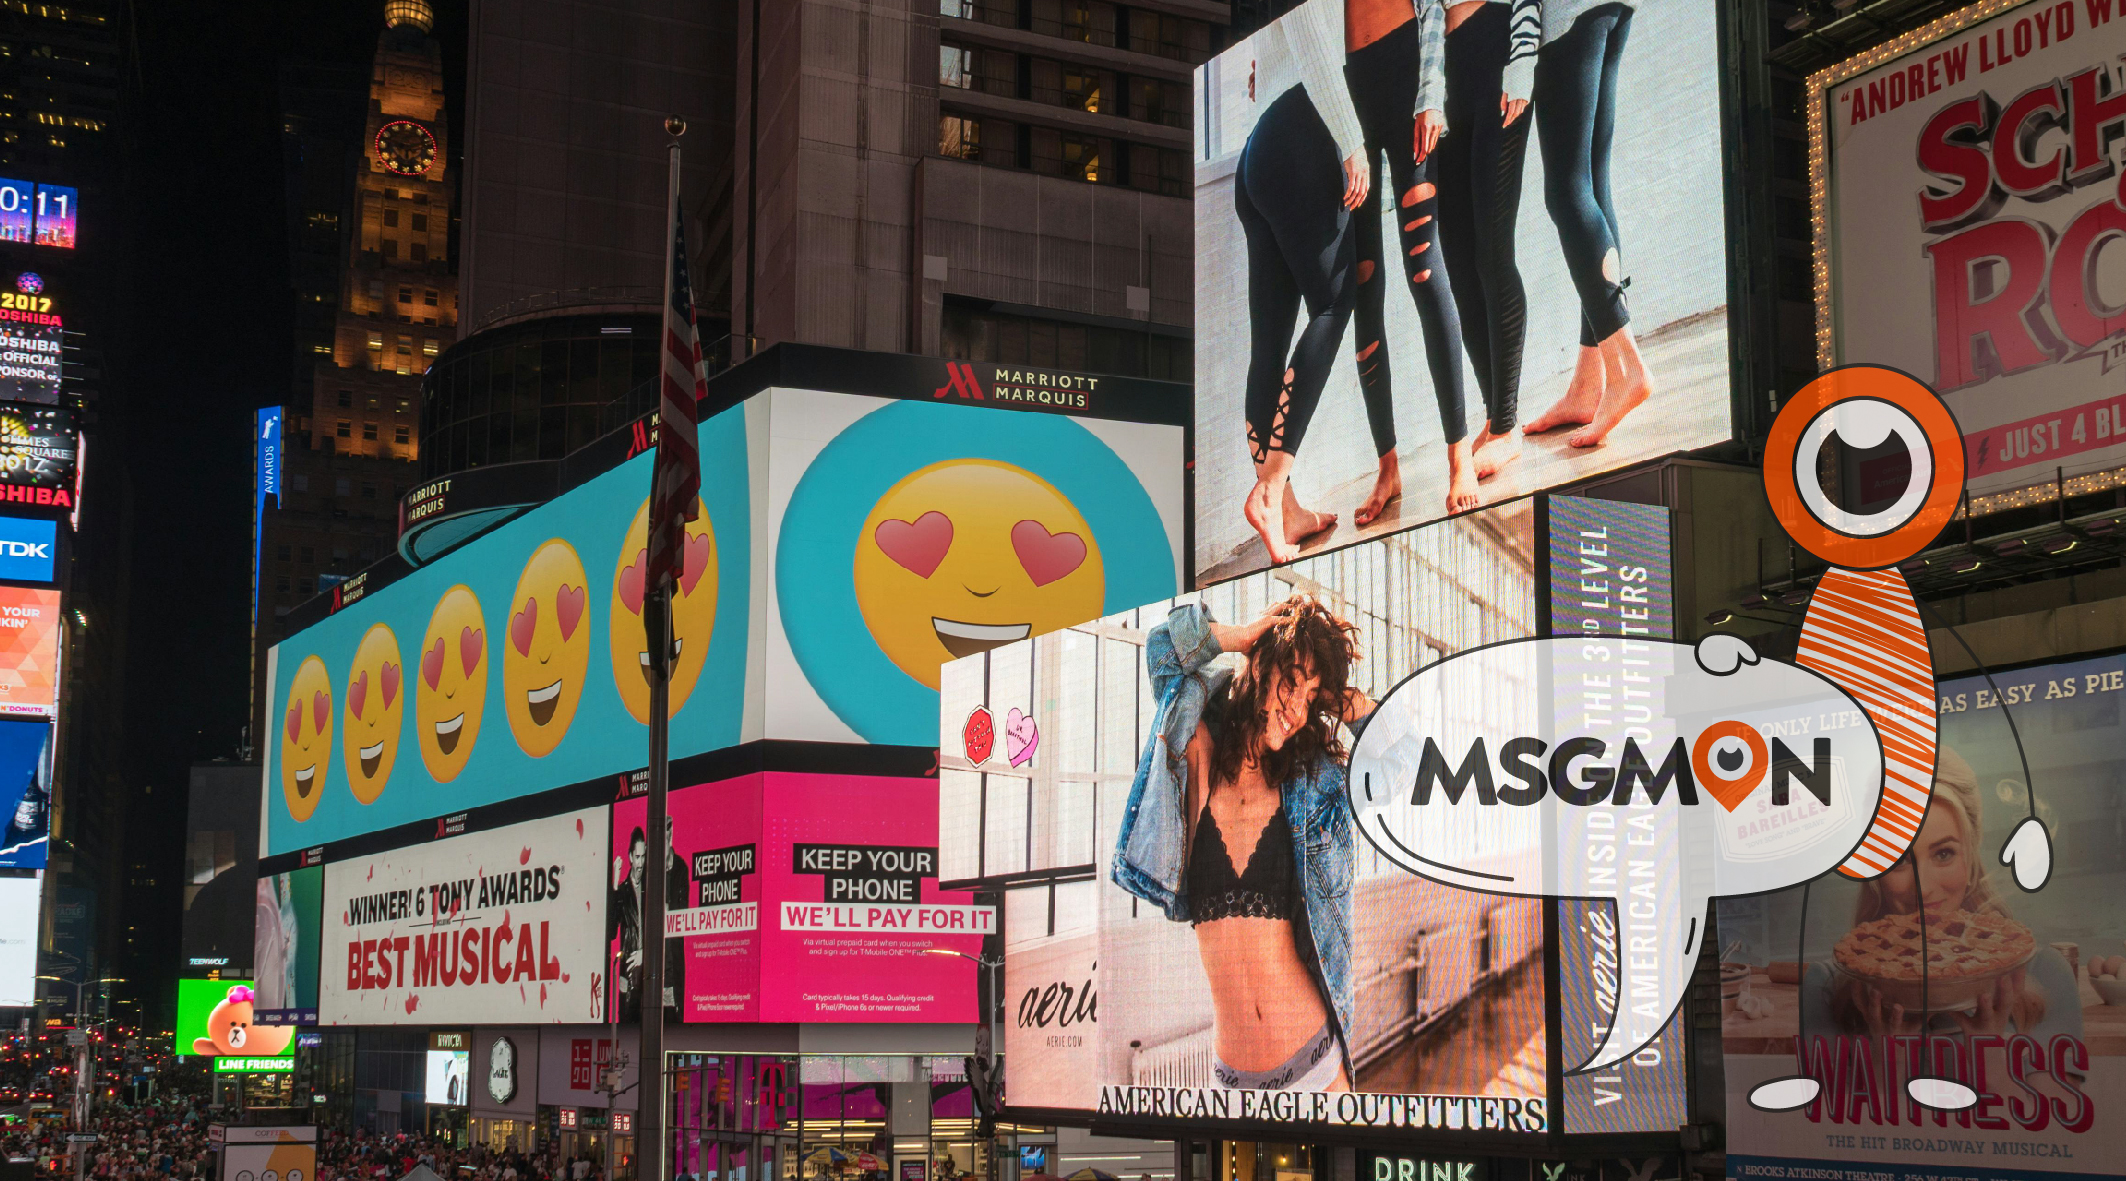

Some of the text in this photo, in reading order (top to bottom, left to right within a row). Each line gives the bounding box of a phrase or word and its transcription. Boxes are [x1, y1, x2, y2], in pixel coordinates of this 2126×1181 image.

[1979, 1, 2075, 74] LLOYD
[1, 292, 51, 314] 2017
[3, 351, 59, 366] OFFICIAL
[0, 366, 46, 380] ONSOR
[995, 368, 1099, 391] MARRIOTT
[995, 387, 1086, 407] MARQUIS
[2000, 418, 2063, 462] JUST
[2071, 412, 2087, 444] 4
[264, 445, 275, 494] AWARDS
[1579, 526, 1610, 609] LEVEL
[2, 606, 41, 618] YOUR
[1618, 565, 1652, 746] OUTFITTERS
[1582, 673, 1613, 729] THE
[1760, 716, 1812, 740] ONLY
[1819, 710, 1862, 732] LIFE
[1940, 693, 1968, 714] AS
[1976, 684, 2036, 710] EASY
[2045, 677, 2077, 700] AS
[2085, 670, 2125, 694] PIE
[1756, 788, 1802, 815] SARA
[1737, 797, 1830, 841] BAREILLES
[694, 849, 753, 877] KEEP YOUR
[801, 848, 932, 873] KEEP YOUR
[349, 889, 412, 926] WINNER!
[415, 886, 425, 917] 6
[429, 878, 475, 916] TONY
[702, 879, 738, 904] PHONE
[832, 878, 913, 901] PHONE
[666, 905, 756, 934] WE'LL PAY FOR IT
[786, 905, 993, 930] WE'LL PAY FOR IT
[836, 939, 862, 948] prepaid
[911, 940, 933, 948] switch
[1627, 860, 1661, 1020] AMERICAN
[347, 920, 560, 991] BEST MUSICAL
[1632, 1029, 1662, 1068] OF
[219, 1059, 294, 1070] LINE FRIENDS
[1593, 1022, 1623, 1107] VISIT
[1793, 1033, 2095, 1134] WAITRESS
[1097, 1085, 1546, 1132] AMERICAN EAGLE OUTFITTERS
[1825, 1134, 2074, 1158] THE HIT BROADWAY MUSICAL
[1376, 1156, 1475, 1181] DRINK
[1745, 1164, 1785, 1178] BROOKS
[1786, 1167, 1843, 1180] ATKINSON
[1845, 1170, 1895, 1181] THEATRE
